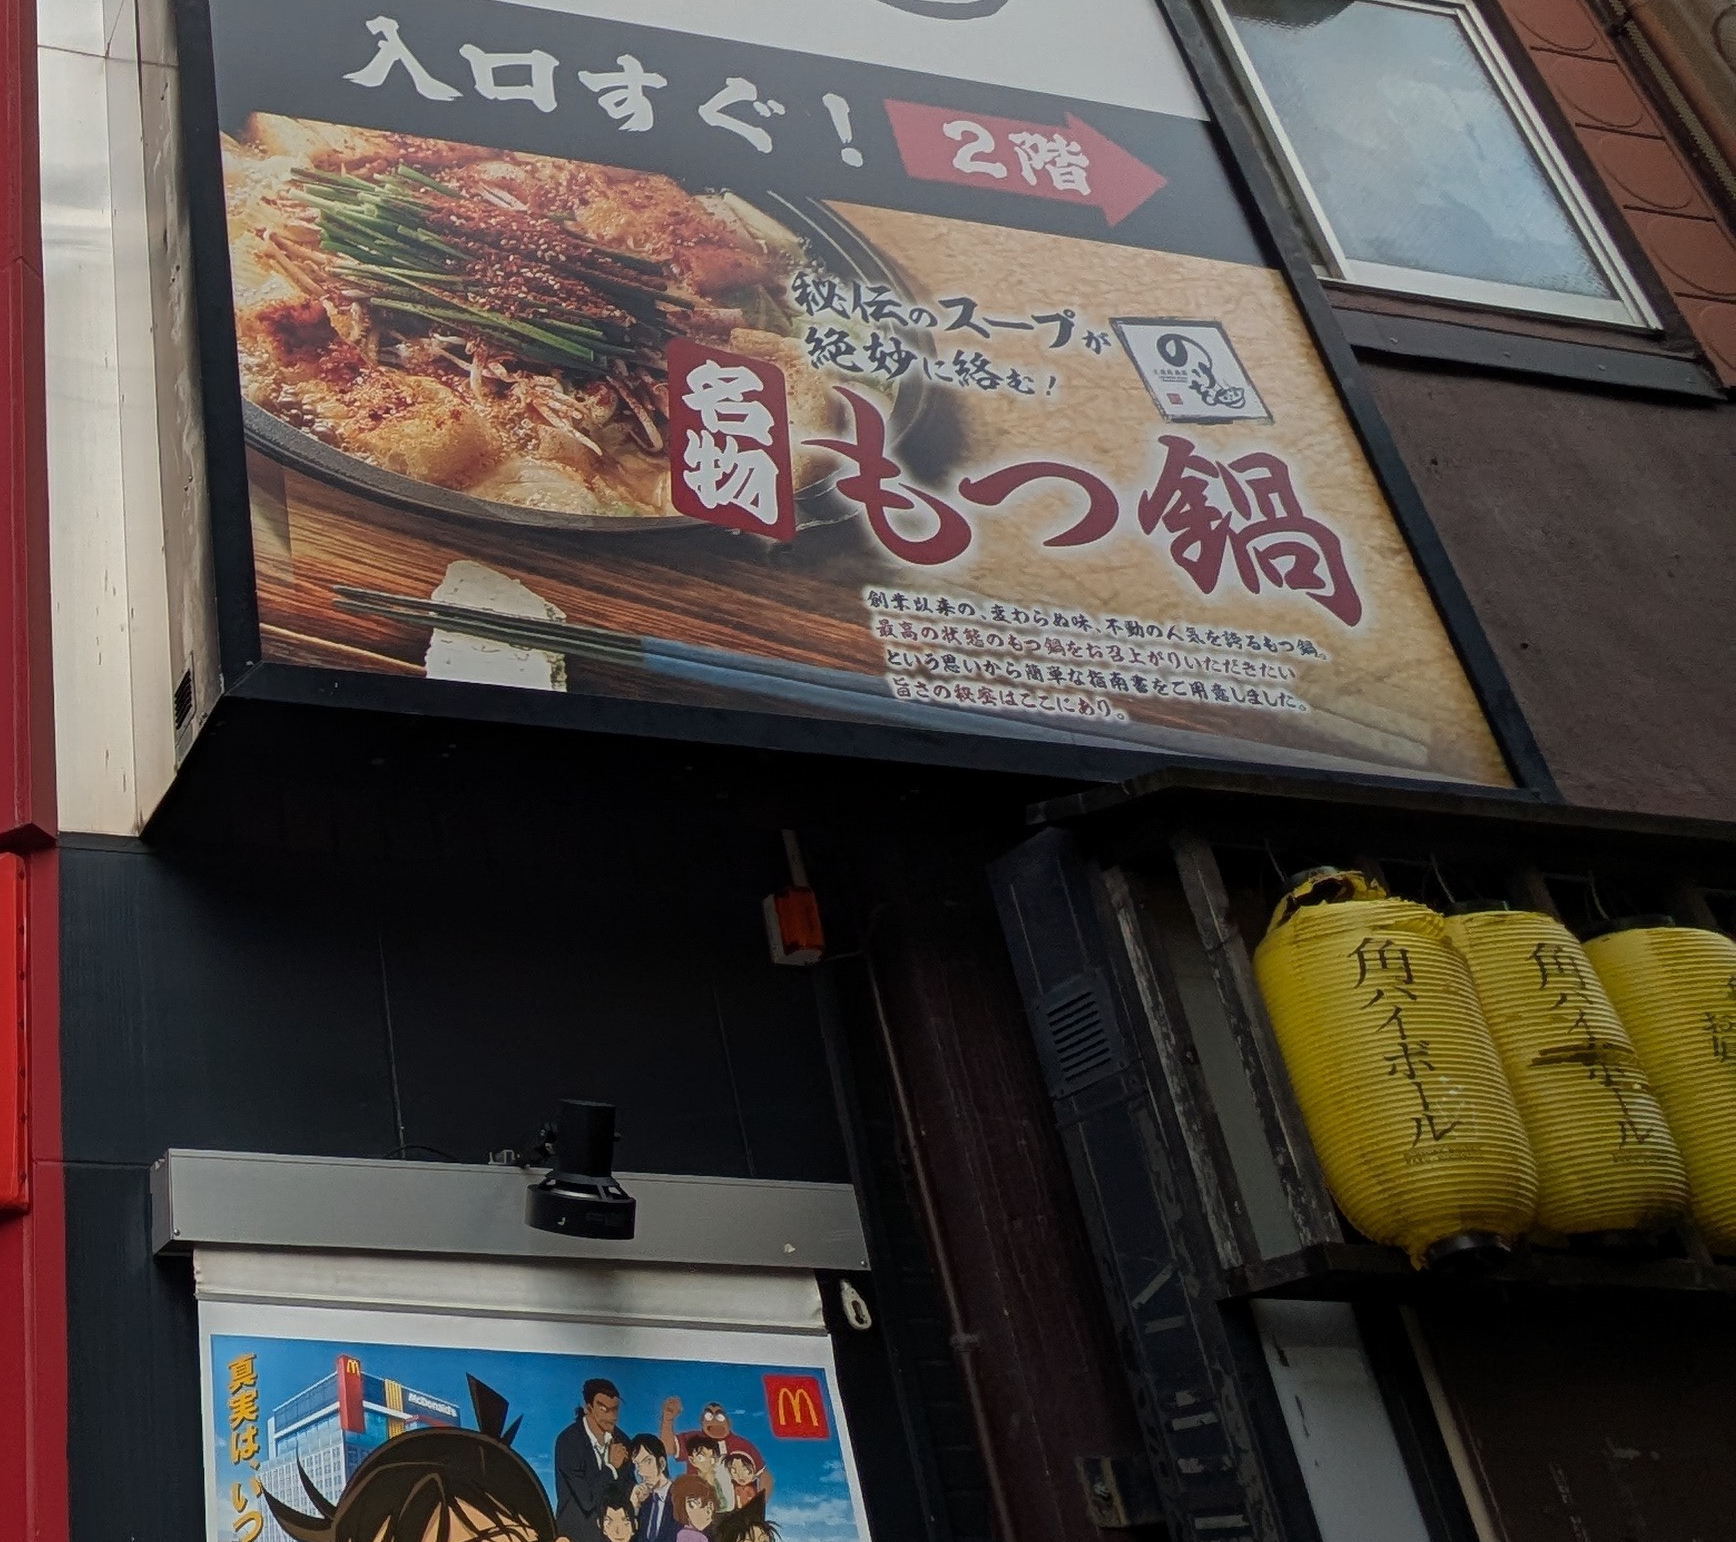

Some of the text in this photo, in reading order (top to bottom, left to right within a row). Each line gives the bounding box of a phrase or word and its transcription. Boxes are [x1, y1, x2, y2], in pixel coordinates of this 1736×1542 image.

[943, 118, 1090, 196] 2階
[792, 270, 1111, 354] 秘伝のスープが
[683, 359, 779, 528] 名物
[801, 386, 1363, 627] もつ鍋
[1347, 936, 1460, 1148] 角ハイボール
